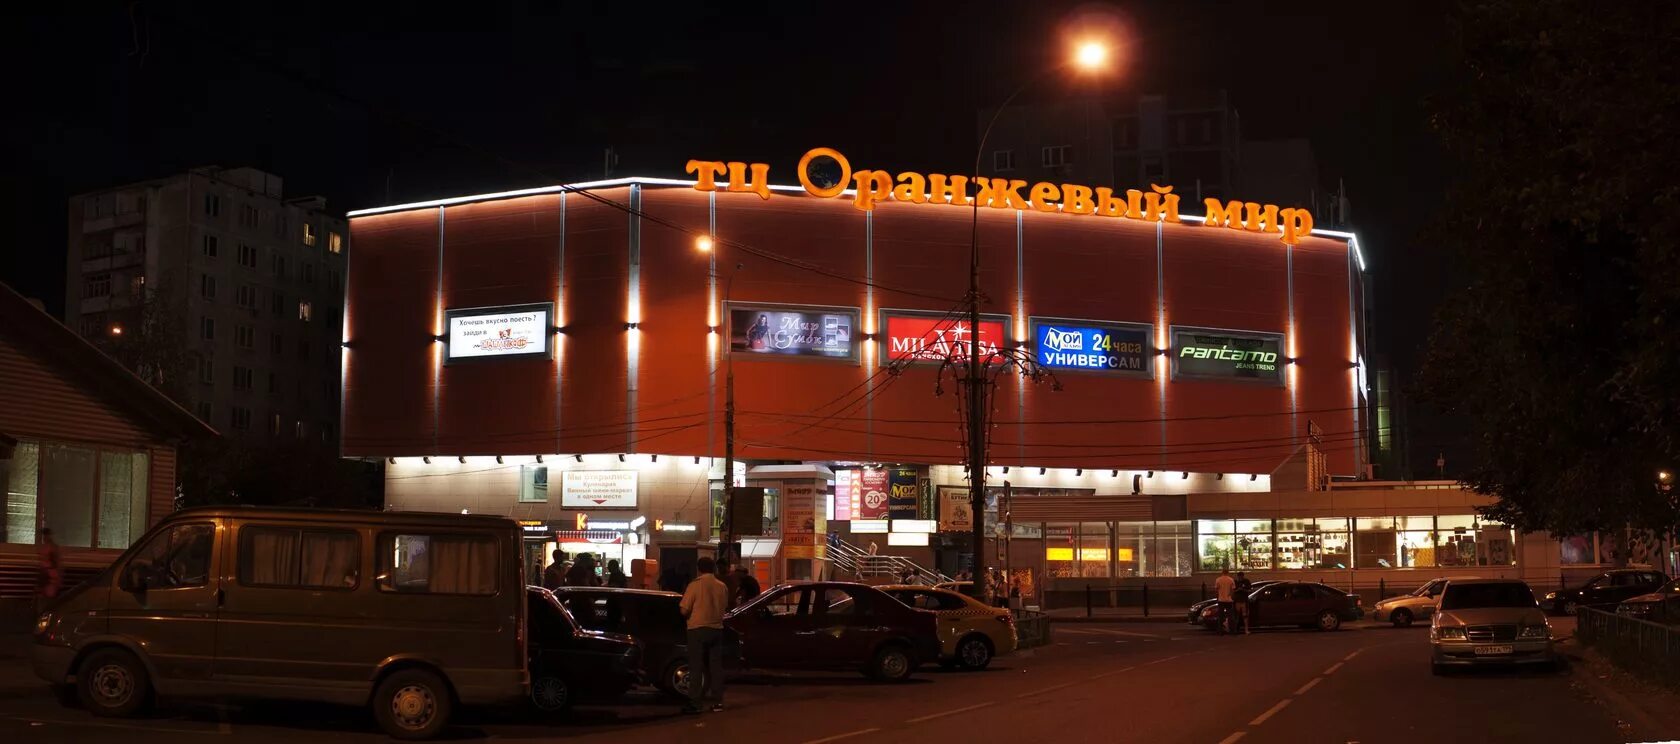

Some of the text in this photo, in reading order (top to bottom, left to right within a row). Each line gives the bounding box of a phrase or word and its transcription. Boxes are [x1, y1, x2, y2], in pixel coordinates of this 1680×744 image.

[798, 147, 1181, 223] Оранжевый
[1203, 198, 1314, 245] мир
[459, 319, 484, 327] Хочешь
[486, 317, 508, 325] вкусно
[510, 315, 532, 323] поесть
[780, 316, 820, 334] Мир
[1093, 334, 1111, 351] 24
[1113, 341, 1142, 353] часа
[1045, 352, 1140, 369] УНИВЕРСАМ
[1256, 363, 1275, 371] TREND
[867, 495, 880, 504] 20
